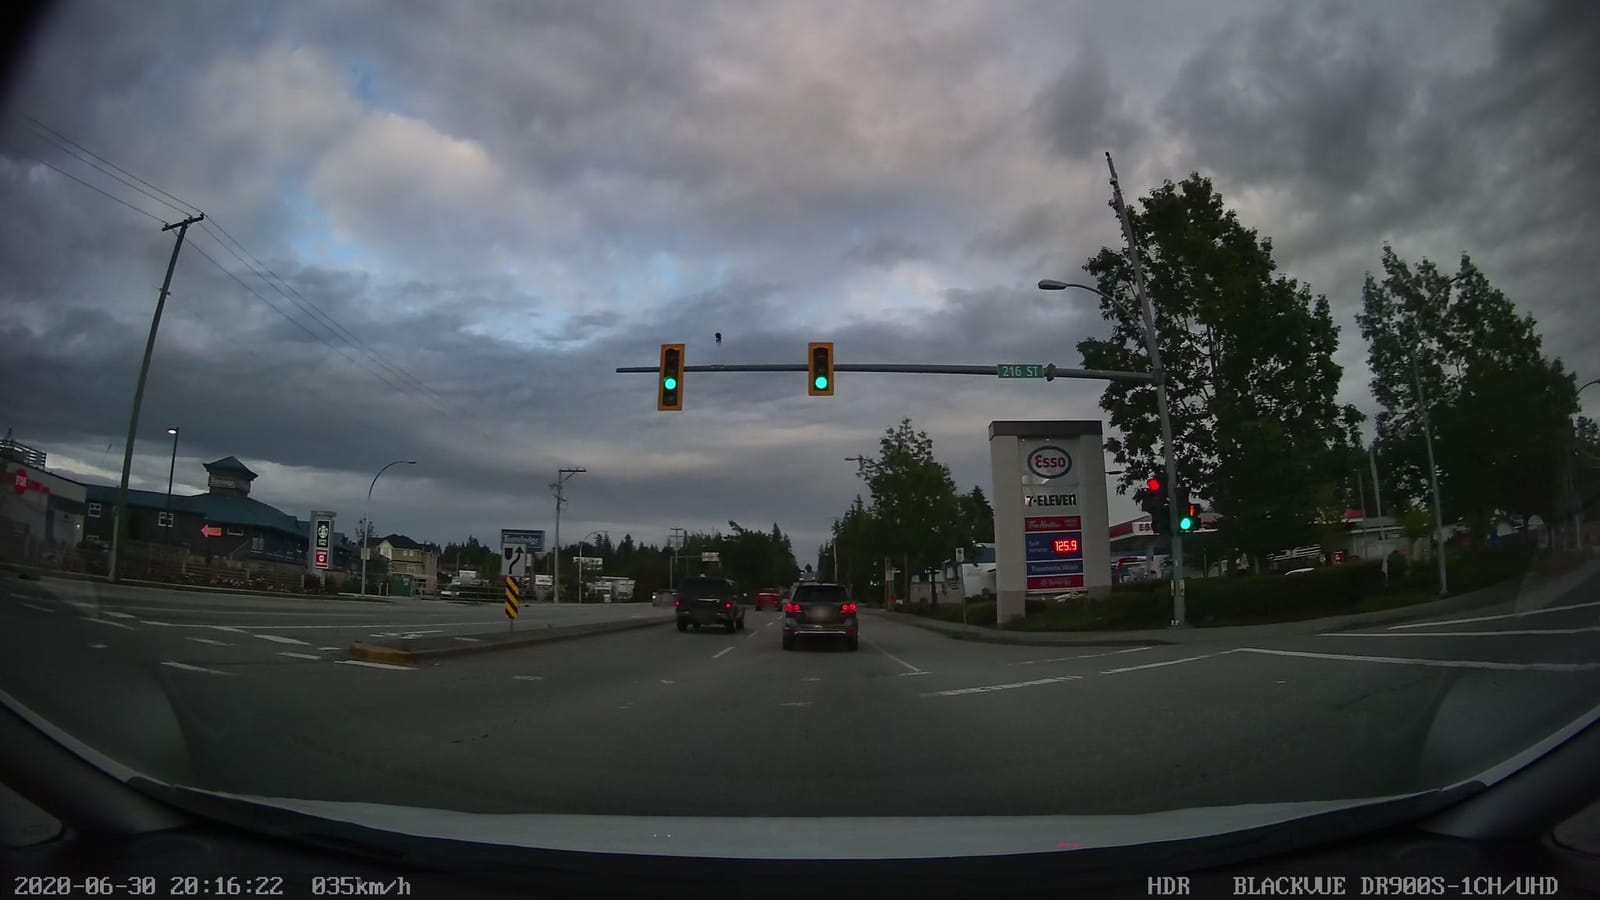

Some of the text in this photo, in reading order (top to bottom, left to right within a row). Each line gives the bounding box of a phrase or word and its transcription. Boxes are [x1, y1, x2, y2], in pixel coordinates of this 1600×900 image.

[1003, 366, 1039, 377] 216 ST
[1034, 454, 1067, 469] Esso
[1054, 540, 1078, 552] 125.9
